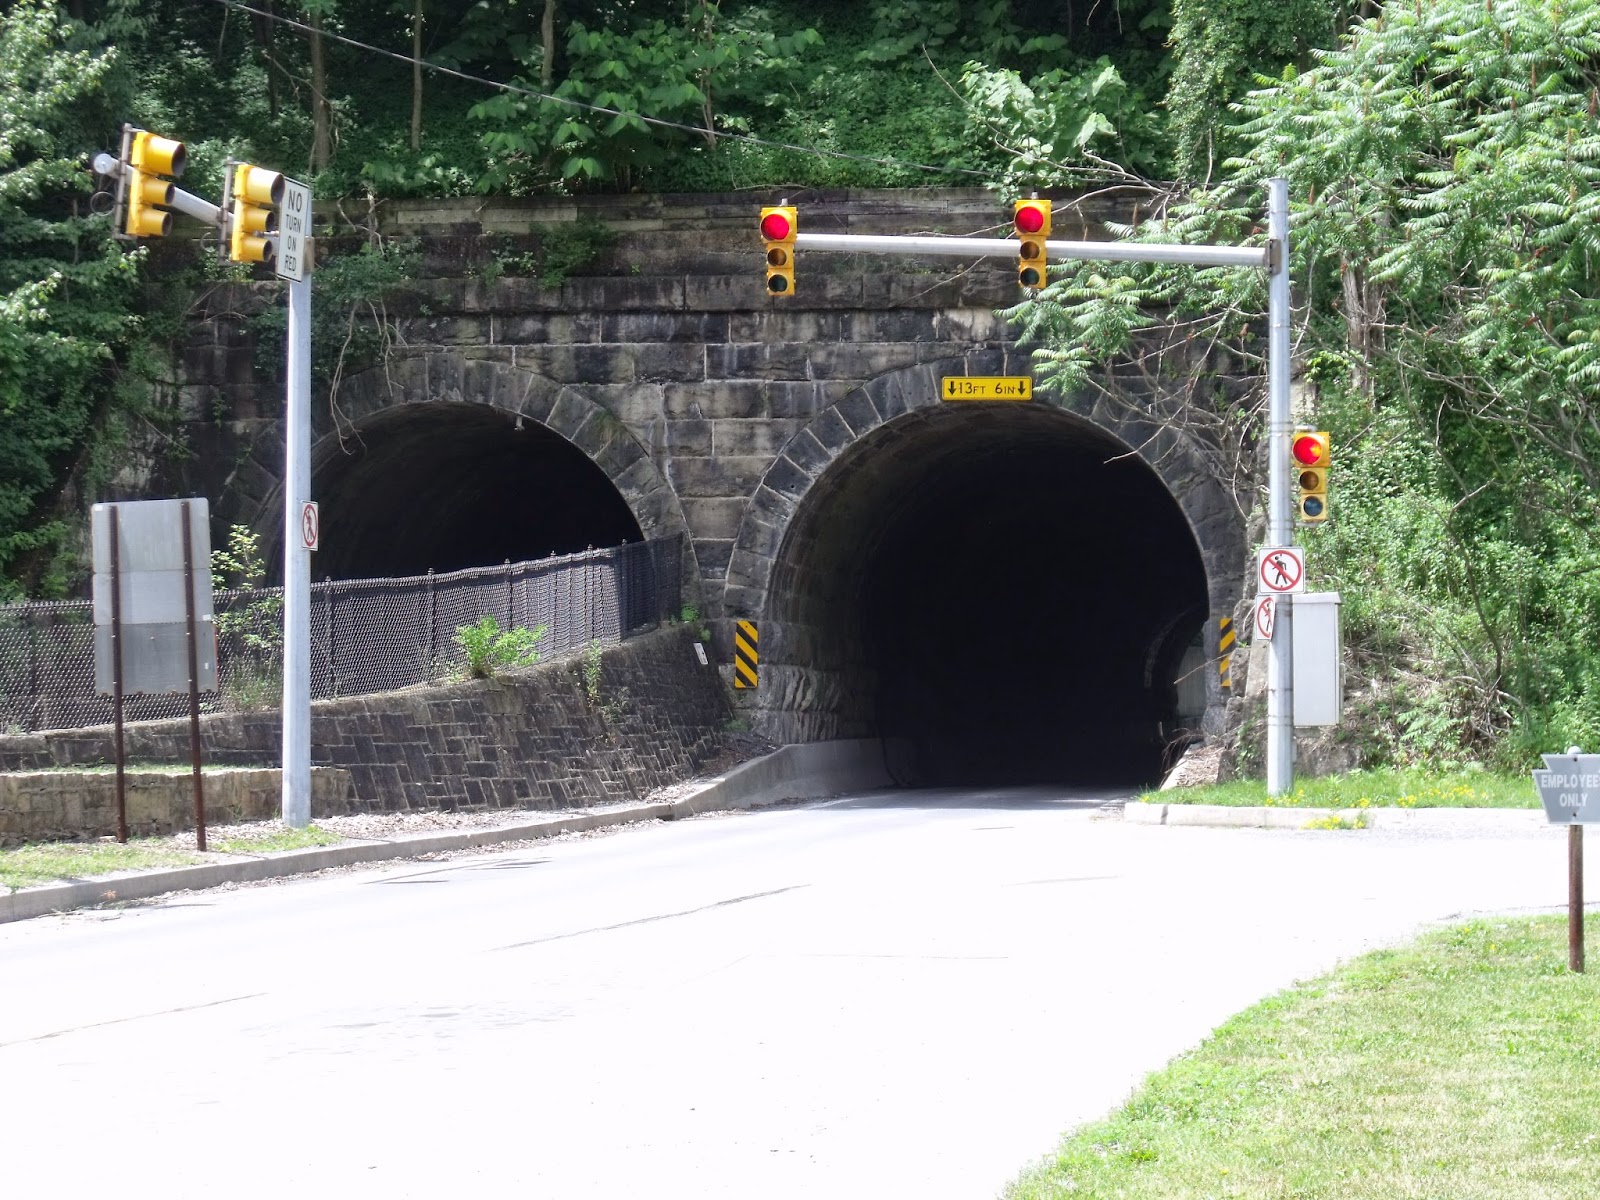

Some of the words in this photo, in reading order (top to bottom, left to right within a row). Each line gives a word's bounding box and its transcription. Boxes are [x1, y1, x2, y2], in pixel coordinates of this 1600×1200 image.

[288, 189, 302, 212] NO
[285, 214, 301, 233] TURN
[287, 236, 296, 251] ON
[285, 254, 296, 271] RED
[1541, 775, 1600, 788] EMPLOYEE
[1559, 793, 1588, 807] ONLY
